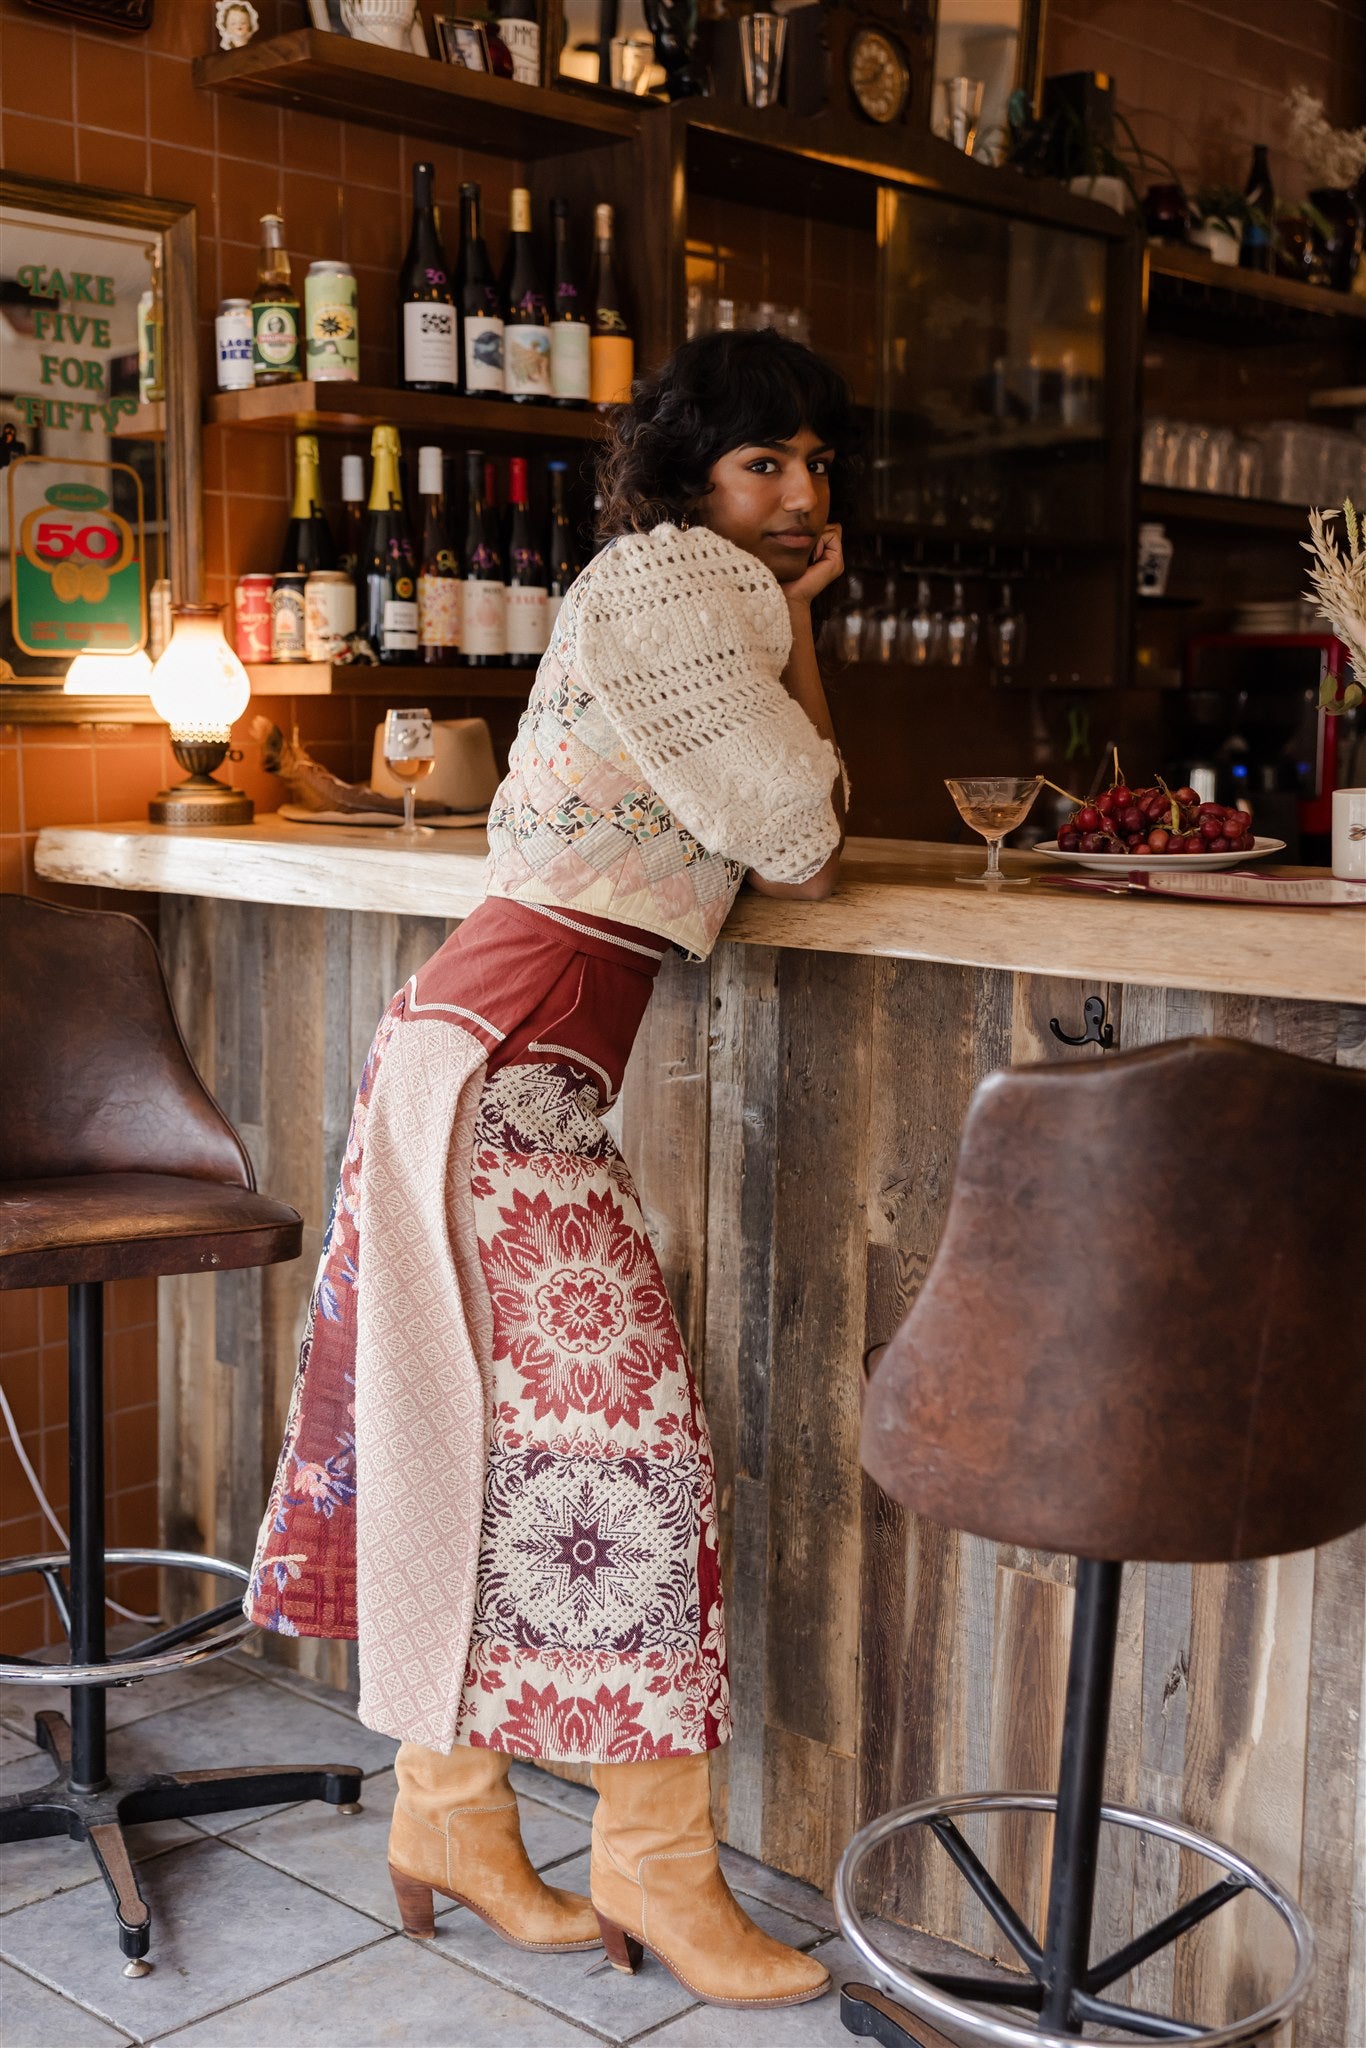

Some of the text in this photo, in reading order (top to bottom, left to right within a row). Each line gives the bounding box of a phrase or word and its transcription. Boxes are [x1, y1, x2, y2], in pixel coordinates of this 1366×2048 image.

[17, 264, 116, 306] TAKE
[424, 267, 447, 285] 30
[33, 310, 112, 349] FIVE
[40, 353, 105, 391] FOR
[15, 396, 138, 434] FIFTY
[36, 523, 119, 561] 50
